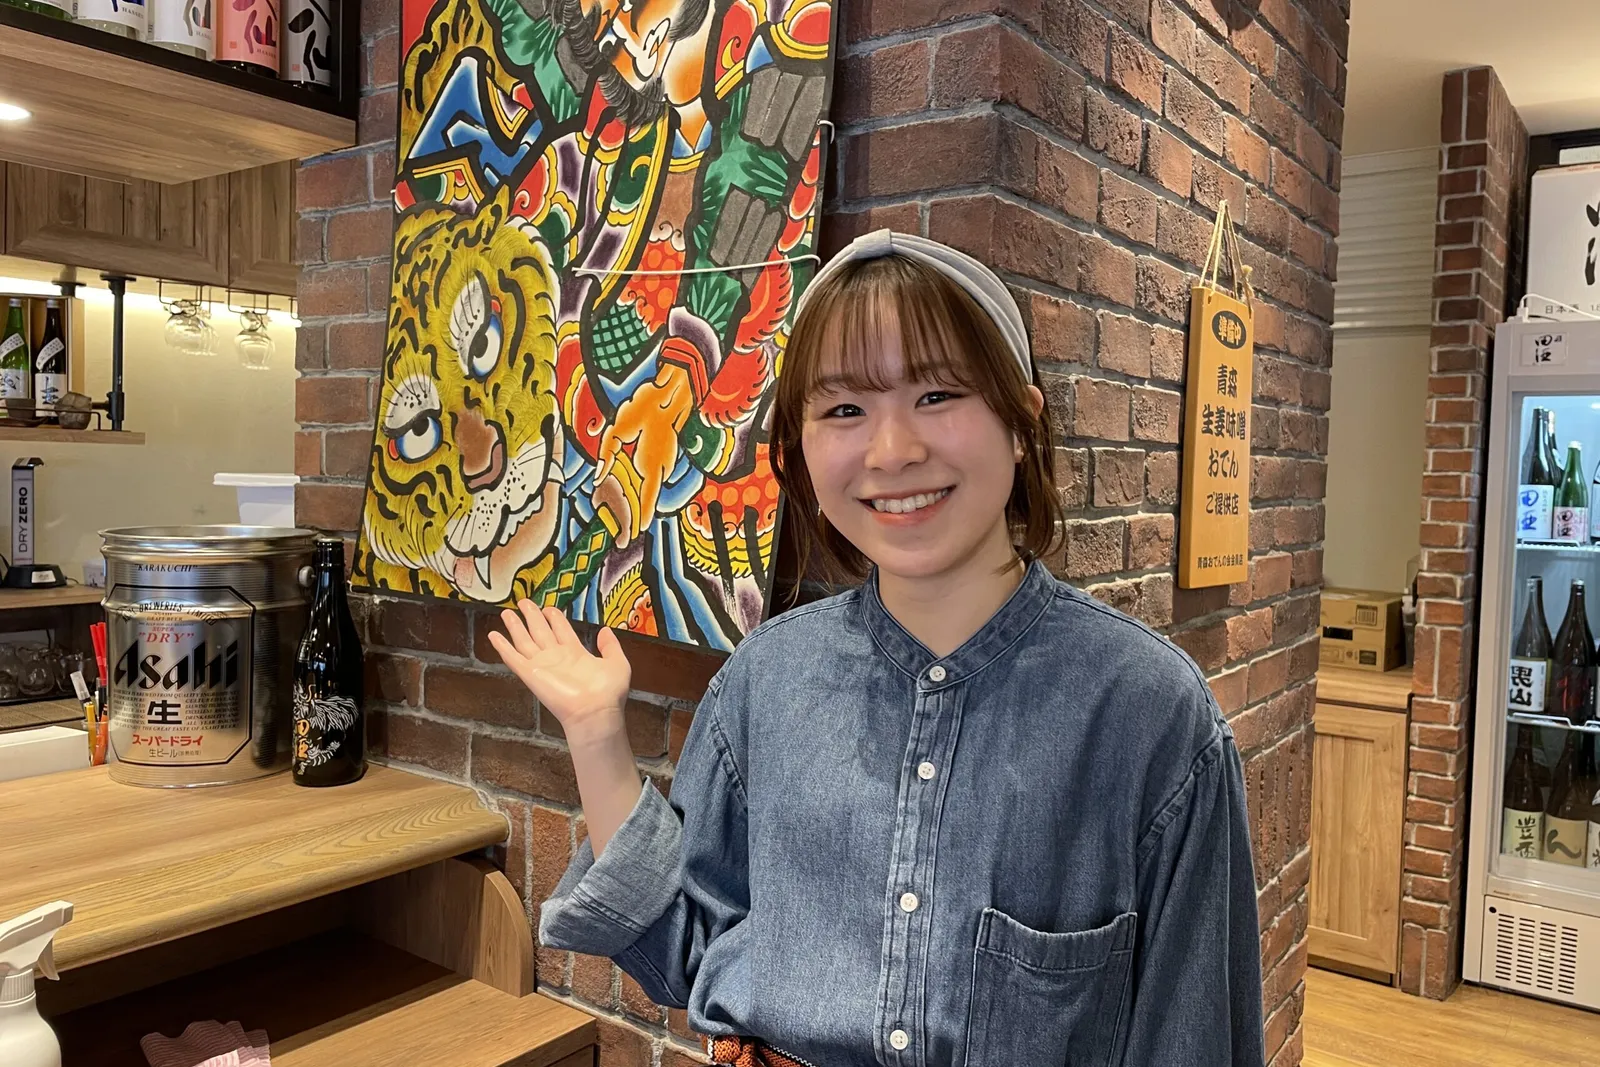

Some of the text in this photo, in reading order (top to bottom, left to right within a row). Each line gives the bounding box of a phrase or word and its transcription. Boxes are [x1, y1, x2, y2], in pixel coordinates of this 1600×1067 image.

[1217, 363, 1238, 399] 青森
[1201, 403, 1246, 440] 生姜味噌
[1208, 447, 1239, 478] おでん
[18, 486, 28, 523] ZERO
[1206, 491, 1239, 515] ご提供店
[18, 525, 28, 553] DRY
[113, 640, 239, 690] Asahi
[147, 699, 183, 725] 生
[132, 734, 204, 747] スーパードライ
